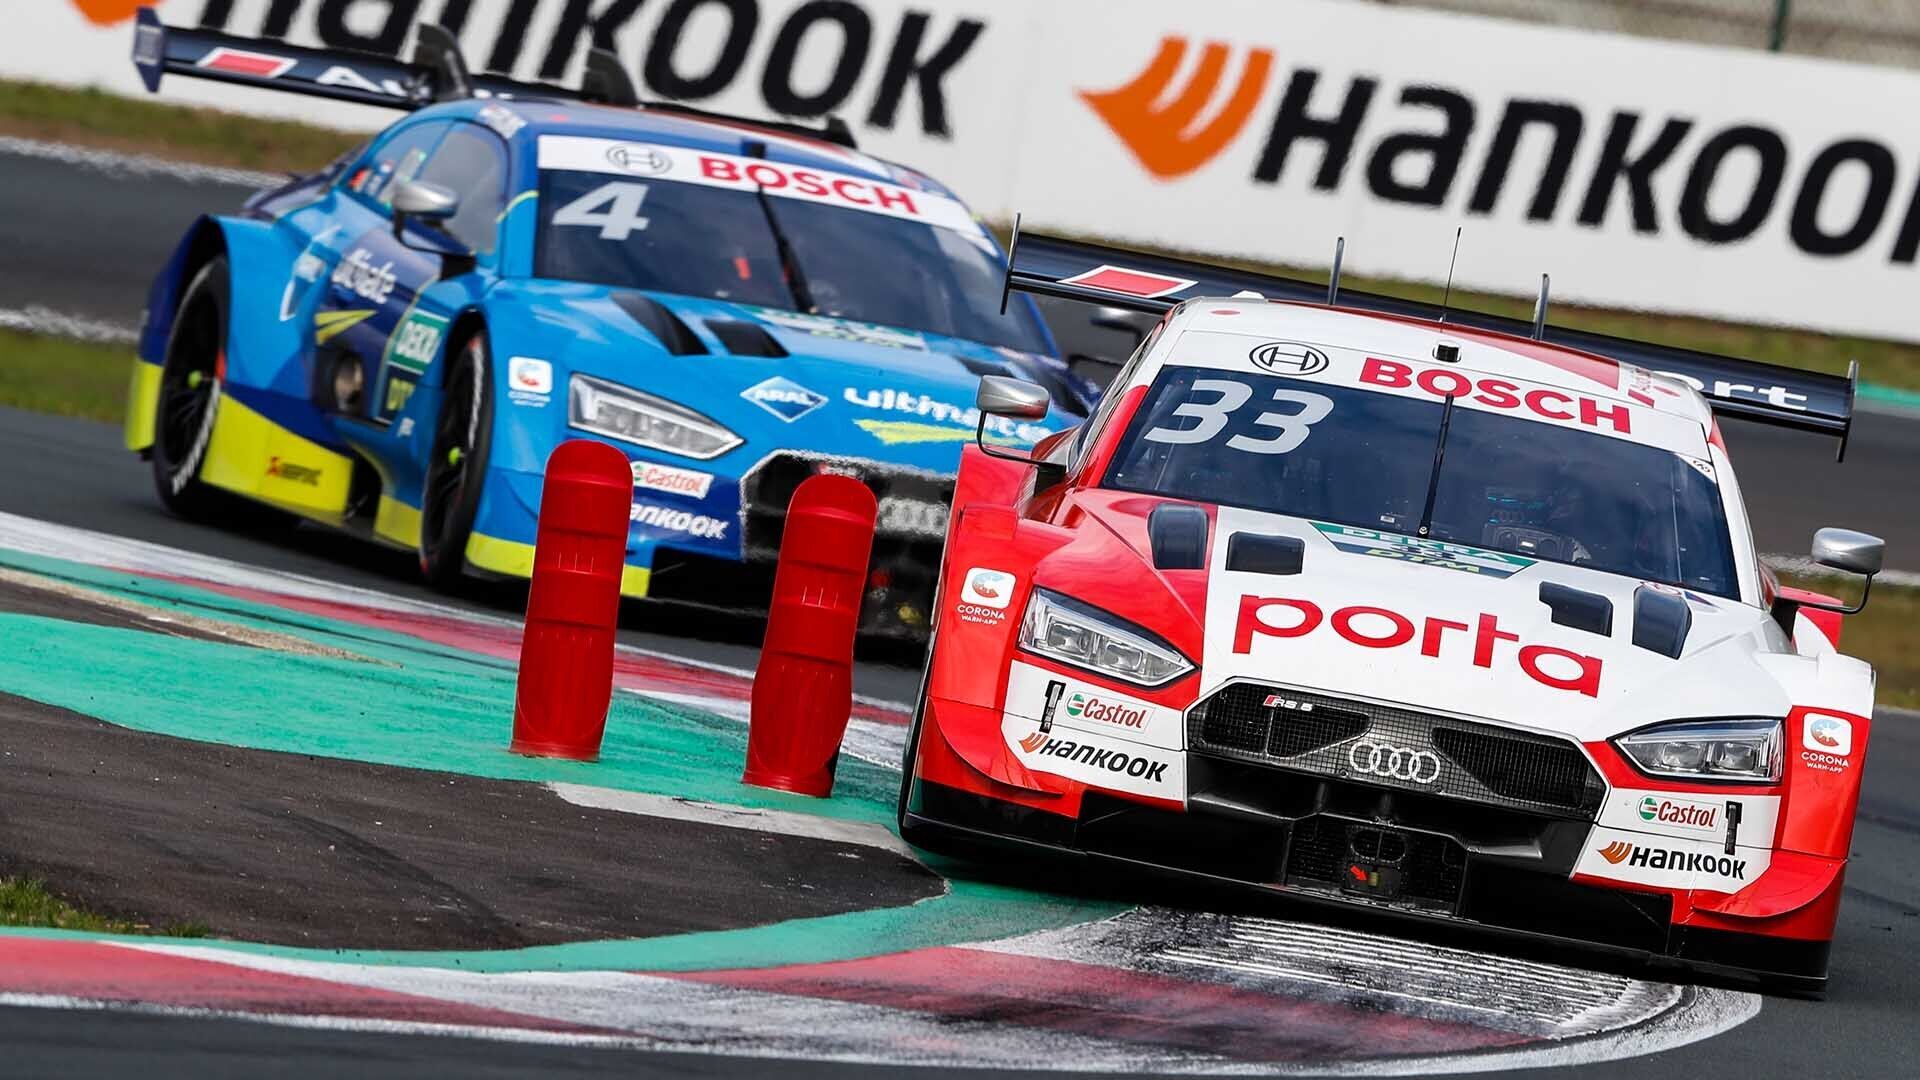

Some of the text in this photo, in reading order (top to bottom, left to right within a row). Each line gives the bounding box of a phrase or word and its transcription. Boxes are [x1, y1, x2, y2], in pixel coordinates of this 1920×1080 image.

[699, 156, 918, 215] BOSCH
[552, 181, 650, 241] 4
[1359, 357, 1631, 434] BOSCH
[1144, 379, 1334, 454] 33
[645, 467, 706, 492] Castrol
[630, 503, 728, 539] ankook
[1342, 527, 1509, 562] DEKRA
[1362, 548, 1481, 573] DTM
[957, 604, 1005, 620] CORONA
[961, 614, 998, 625] WARN-APP
[1232, 594, 1602, 698] porta
[1083, 698, 1147, 728] Castrol
[1273, 698, 1297, 710] RS
[1801, 751, 1849, 768] CORONA
[1806, 761, 1843, 774] WARN-APP
[1658, 801, 1716, 827] Castrol
